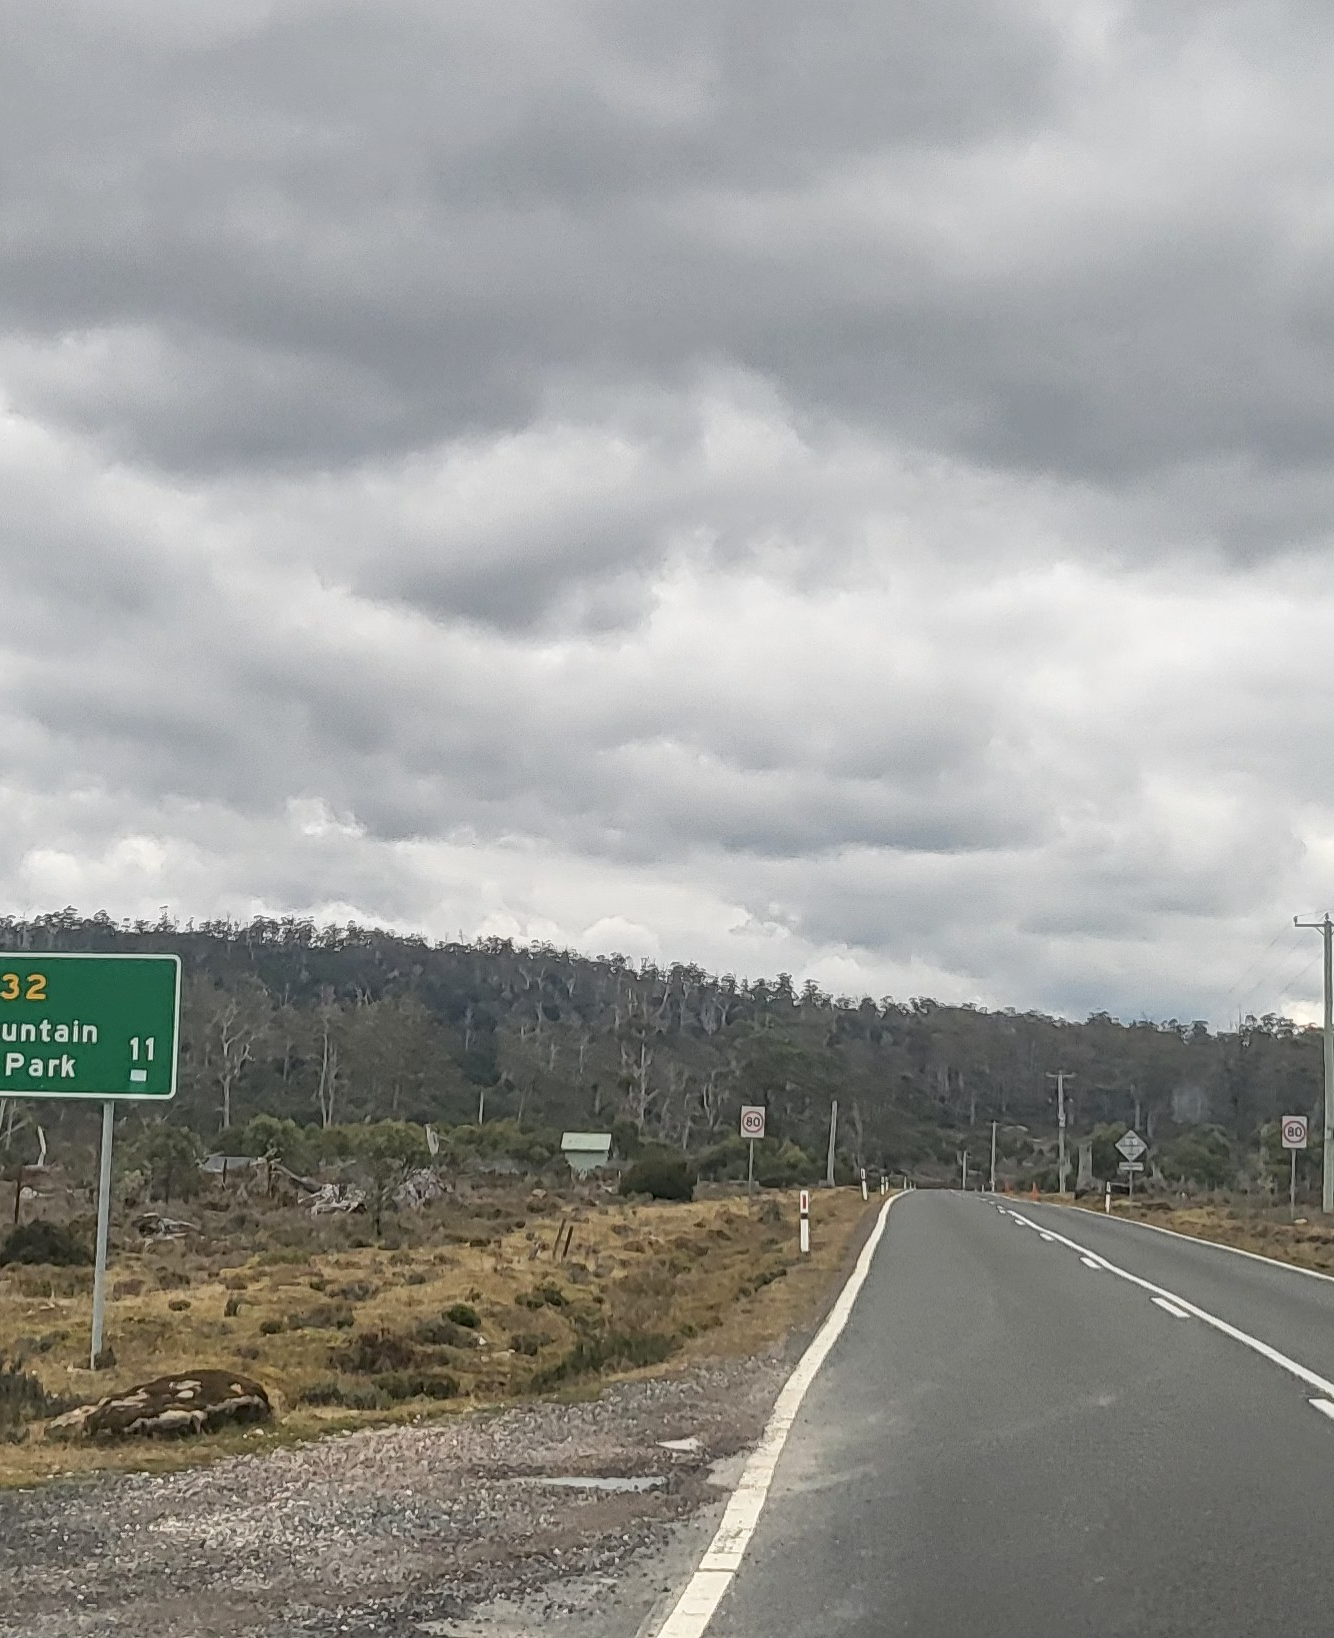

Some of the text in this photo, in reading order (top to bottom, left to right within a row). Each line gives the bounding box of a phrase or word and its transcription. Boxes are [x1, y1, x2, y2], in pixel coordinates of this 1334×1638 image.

[129, 1036, 155, 1062] 11
[5, 1052, 76, 1079] Park
[746, 1116, 761, 1128] 80
[1287, 1126, 1303, 1138] 80
